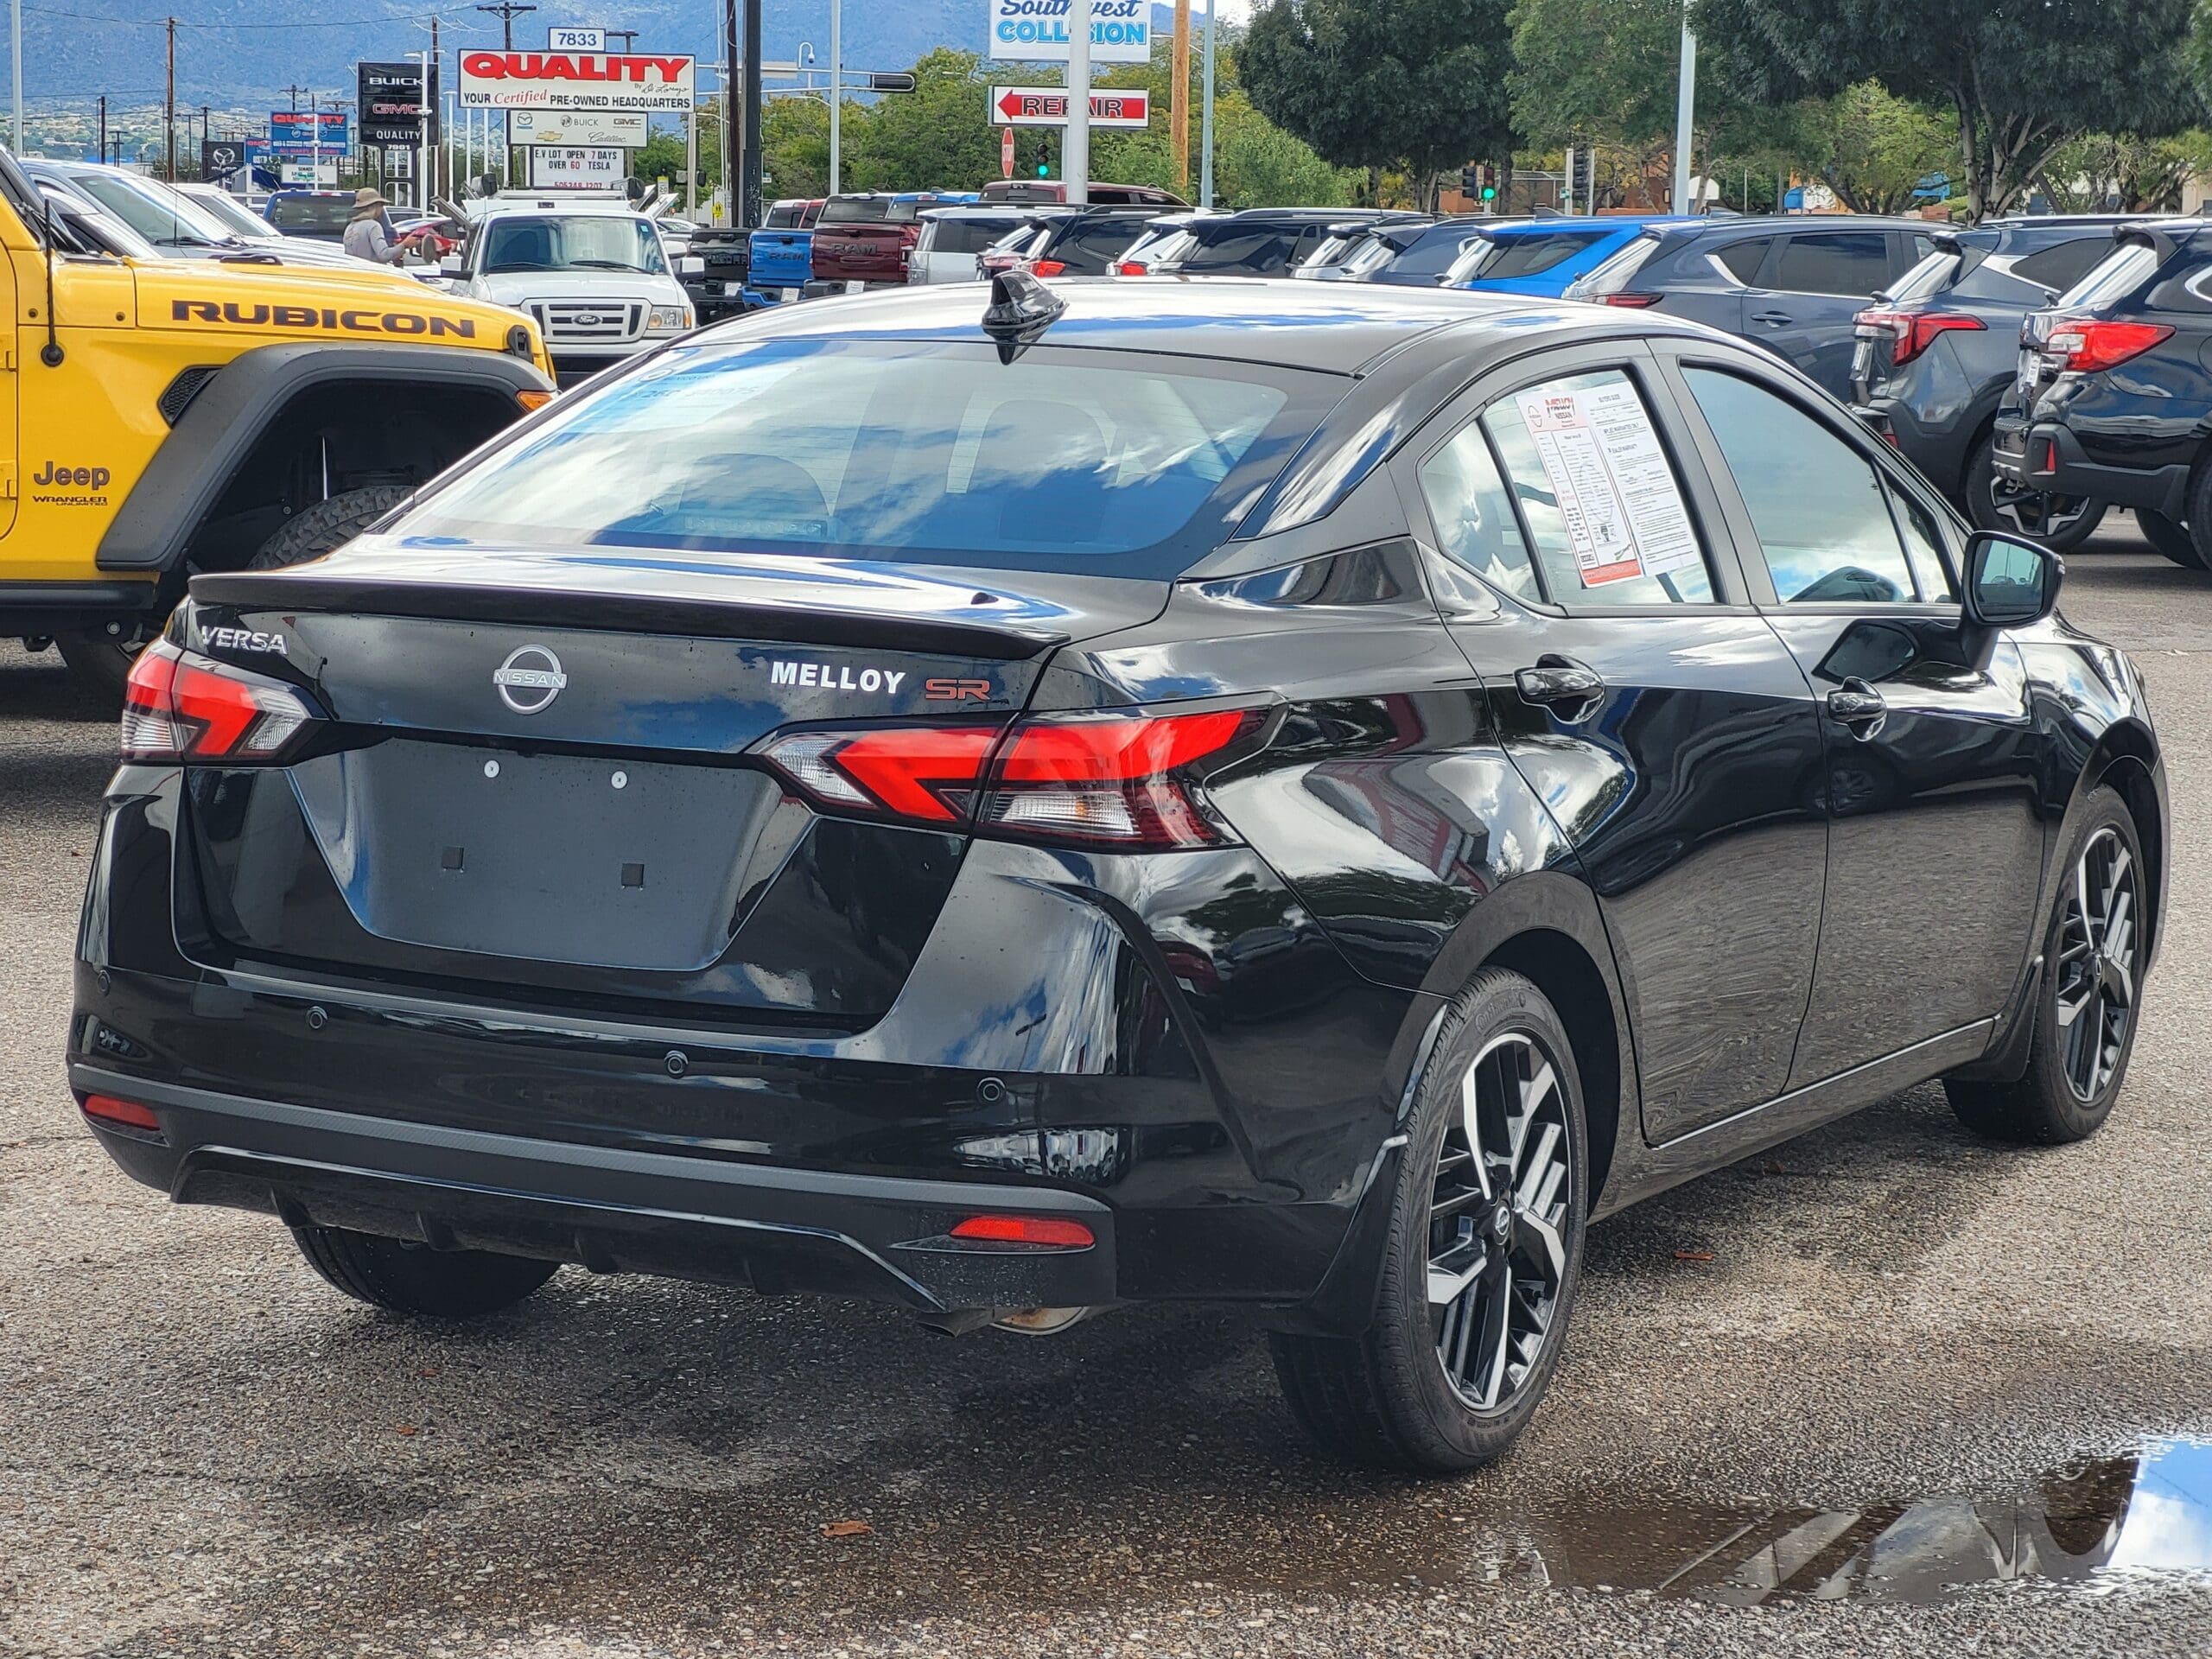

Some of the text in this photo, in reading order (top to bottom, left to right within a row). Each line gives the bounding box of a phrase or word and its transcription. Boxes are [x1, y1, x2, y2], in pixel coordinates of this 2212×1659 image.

[996, 19, 1147, 45] COLLION
[557, 33, 597, 46] 7833
[463, 54, 690, 82] QUALITY
[369, 77, 423, 86] BUICK
[464, 89, 690, 109] YOUR Certified PRE-OWNED HEADQUARTERS
[372, 104, 423, 114] GMC
[273, 114, 345, 124] QUAITY
[376, 130, 423, 139] QUALITY
[549, 150, 561, 159] LOT
[566, 150, 586, 159] OPEN
[598, 151, 617, 160] DAYS
[549, 161, 611, 170] OVER 60 TESLA
[830, 243, 878, 256] RAM
[768, 252, 804, 261] RAM
[172, 300, 477, 340] RUBICON
[33, 461, 111, 491] Jeep
[201, 626, 289, 655] VERSA
[494, 671, 564, 686] NISSAN
[771, 661, 990, 701] MELLOY SR
